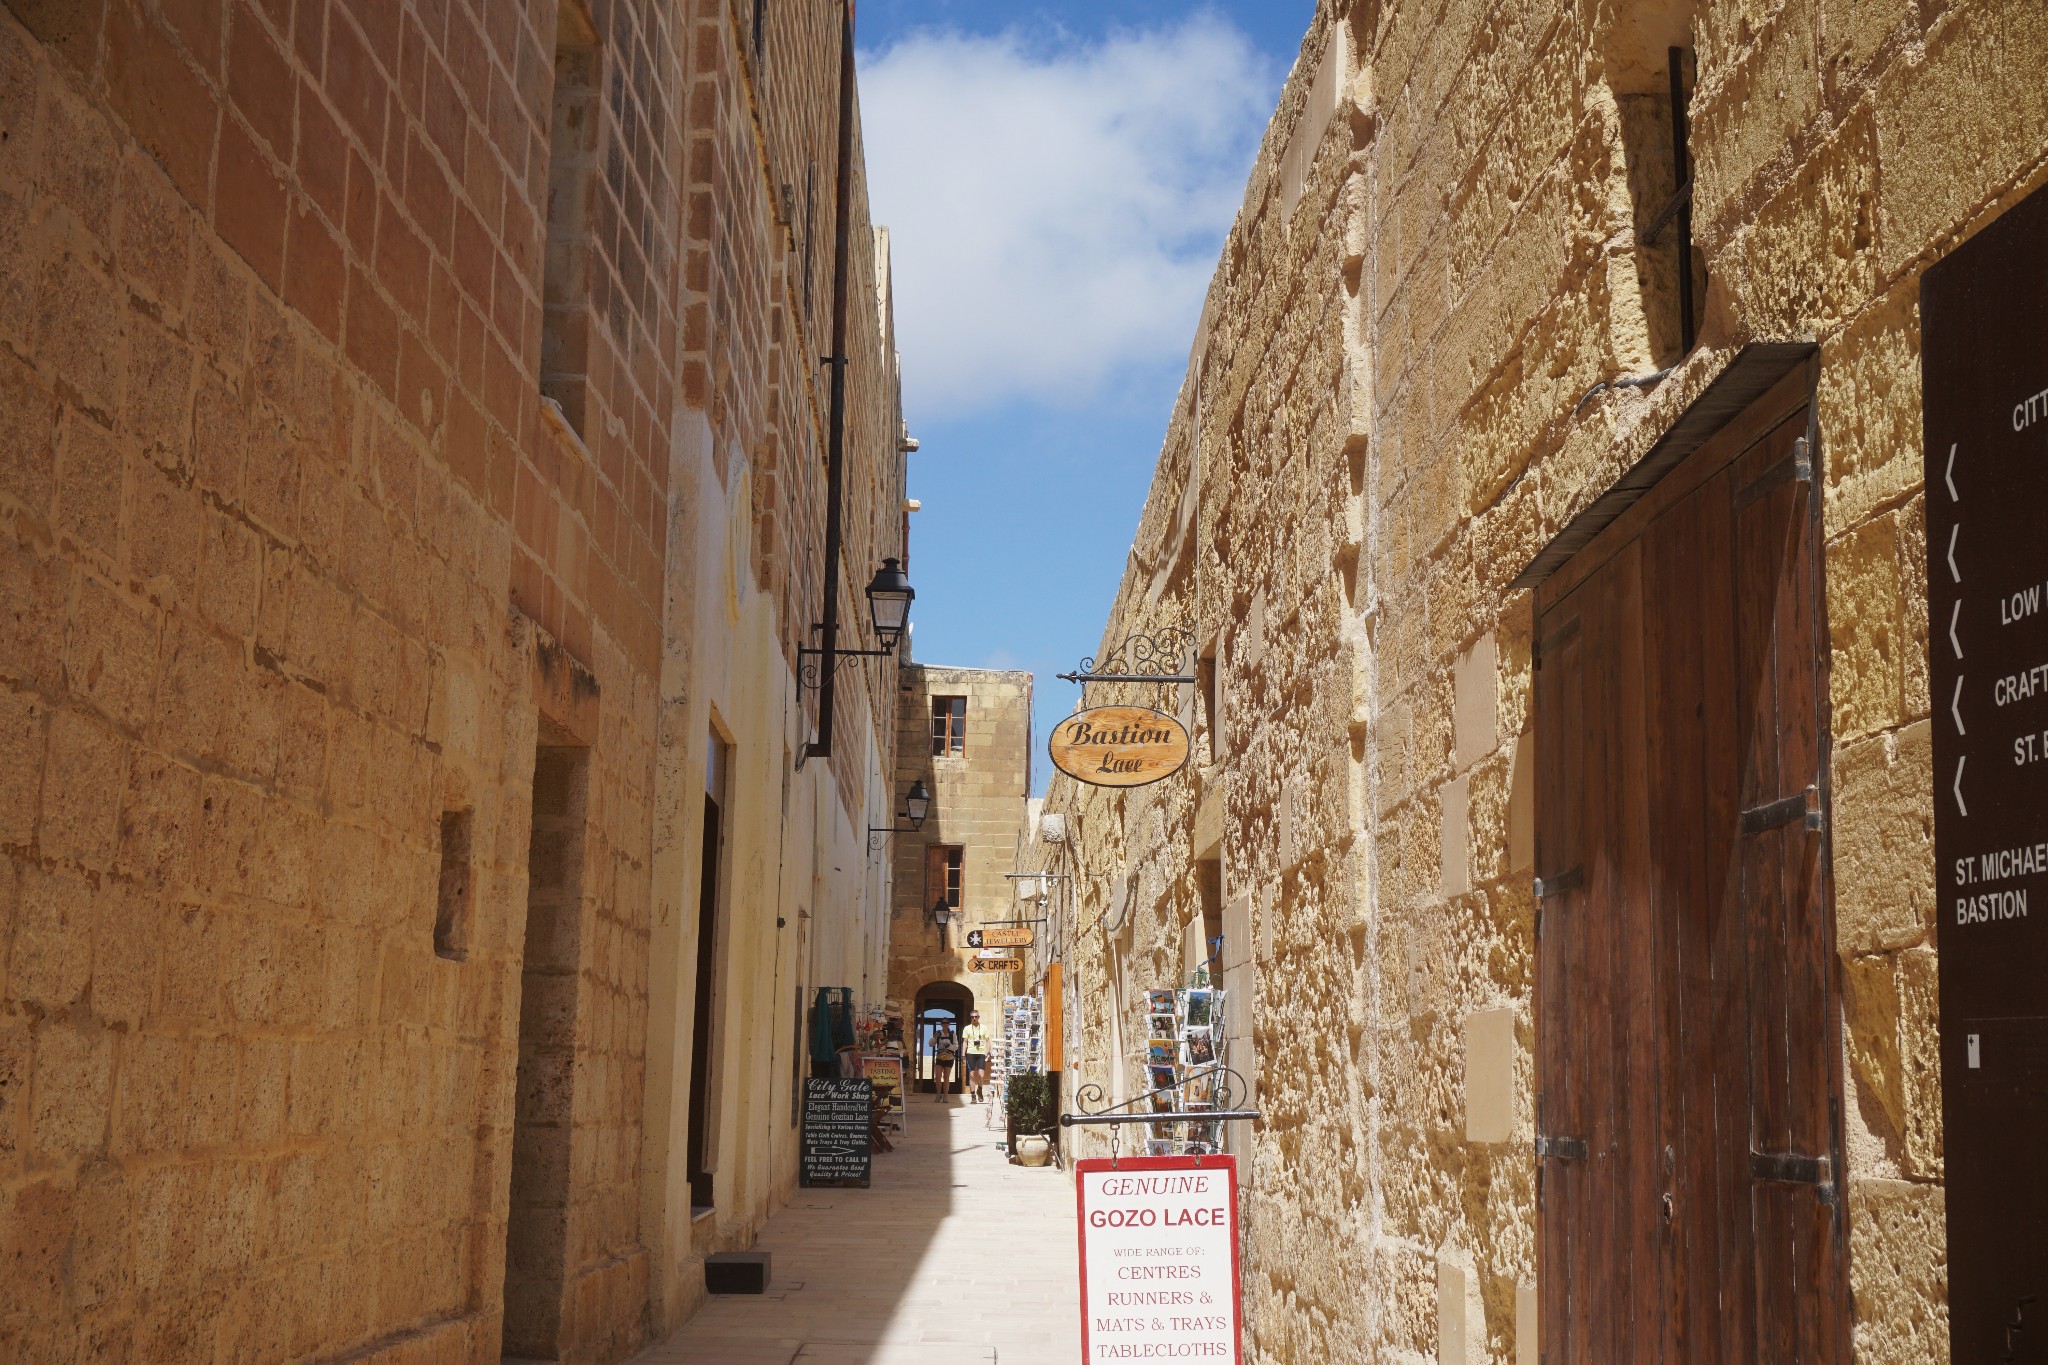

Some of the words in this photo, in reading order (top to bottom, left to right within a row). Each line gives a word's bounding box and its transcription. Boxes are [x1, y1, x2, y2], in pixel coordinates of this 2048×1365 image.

[2001, 584, 2040, 626] LOW
[1066, 722, 1172, 746] Bastion
[2014, 734, 2039, 766] ST.
[1095, 750, 1143, 774] Lace
[1955, 856, 1978, 886] ST.
[1981, 842, 2048, 881] MICHAE
[1956, 889, 2028, 925] BASTION
[988, 960, 1019, 970] CRAFTS
[807, 1078, 836, 1096] City
[839, 1078, 869, 1092] Gate
[852, 1092, 869, 1100] Shop
[808, 1103, 831, 1112] Elegant
[832, 1103, 868, 1111] Handcrafted
[805, 1112, 829, 1120] Genuine
[831, 1112, 854, 1121] Gozitan
[855, 1113, 869, 1121] Lace
[809, 1171, 832, 1179] Quality
[1102, 1176, 1209, 1196] GENUINE
[1090, 1209, 1157, 1228] GOZO
[1164, 1207, 1225, 1227] LACE
[1113, 1248, 1142, 1257] WIDE
[1146, 1247, 1183, 1257] RANGE
[1186, 1247, 1205, 1256] OF:
[1118, 1265, 1201, 1280] CENTRES
[1108, 1291, 1193, 1306] RUNNERS
[1199, 1291, 1213, 1305] &
[1096, 1318, 1145, 1332] MATS
[1151, 1317, 1165, 1331] &
[1170, 1316, 1227, 1331] TRAYS
[1097, 1342, 1227, 1358] TABLECLOTHS
